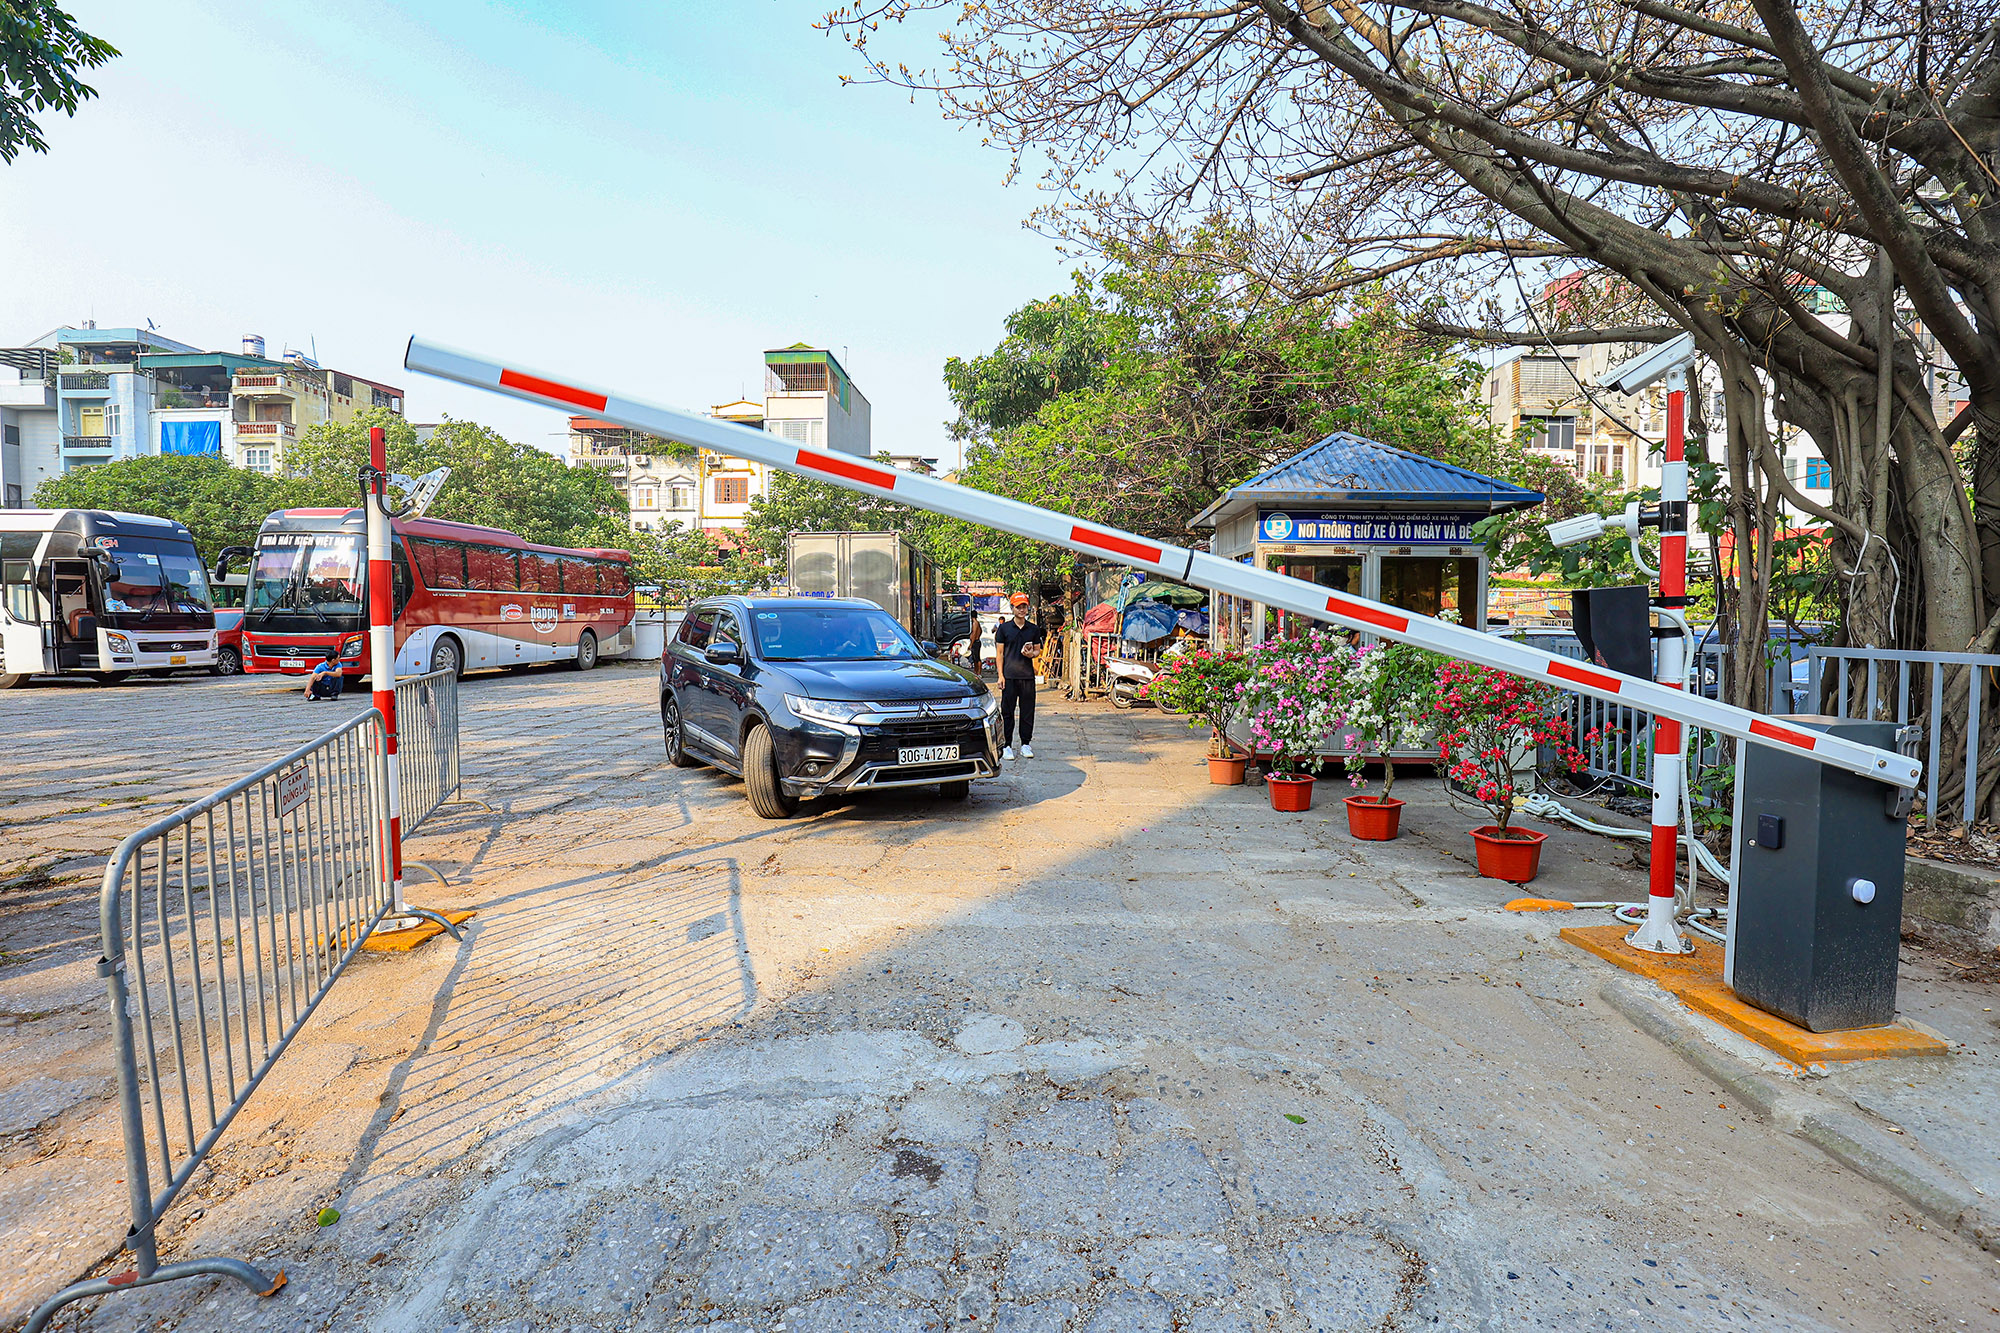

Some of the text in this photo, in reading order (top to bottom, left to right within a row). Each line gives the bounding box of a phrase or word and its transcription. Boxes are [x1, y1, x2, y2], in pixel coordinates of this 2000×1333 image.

[1298, 520, 1477, 540] NƠI TRÔNG GIỮ XE Ô TÔ NGÀY VÀ ĐÊ
[262, 534, 277, 546] NHÀ
[278, 534, 294, 546] HÁT
[294, 535, 314, 548] KỊCH
[315, 535, 334, 548] VIỆT
[530, 606, 559, 620] happy
[900, 746, 958, 763] 30G-412.73
